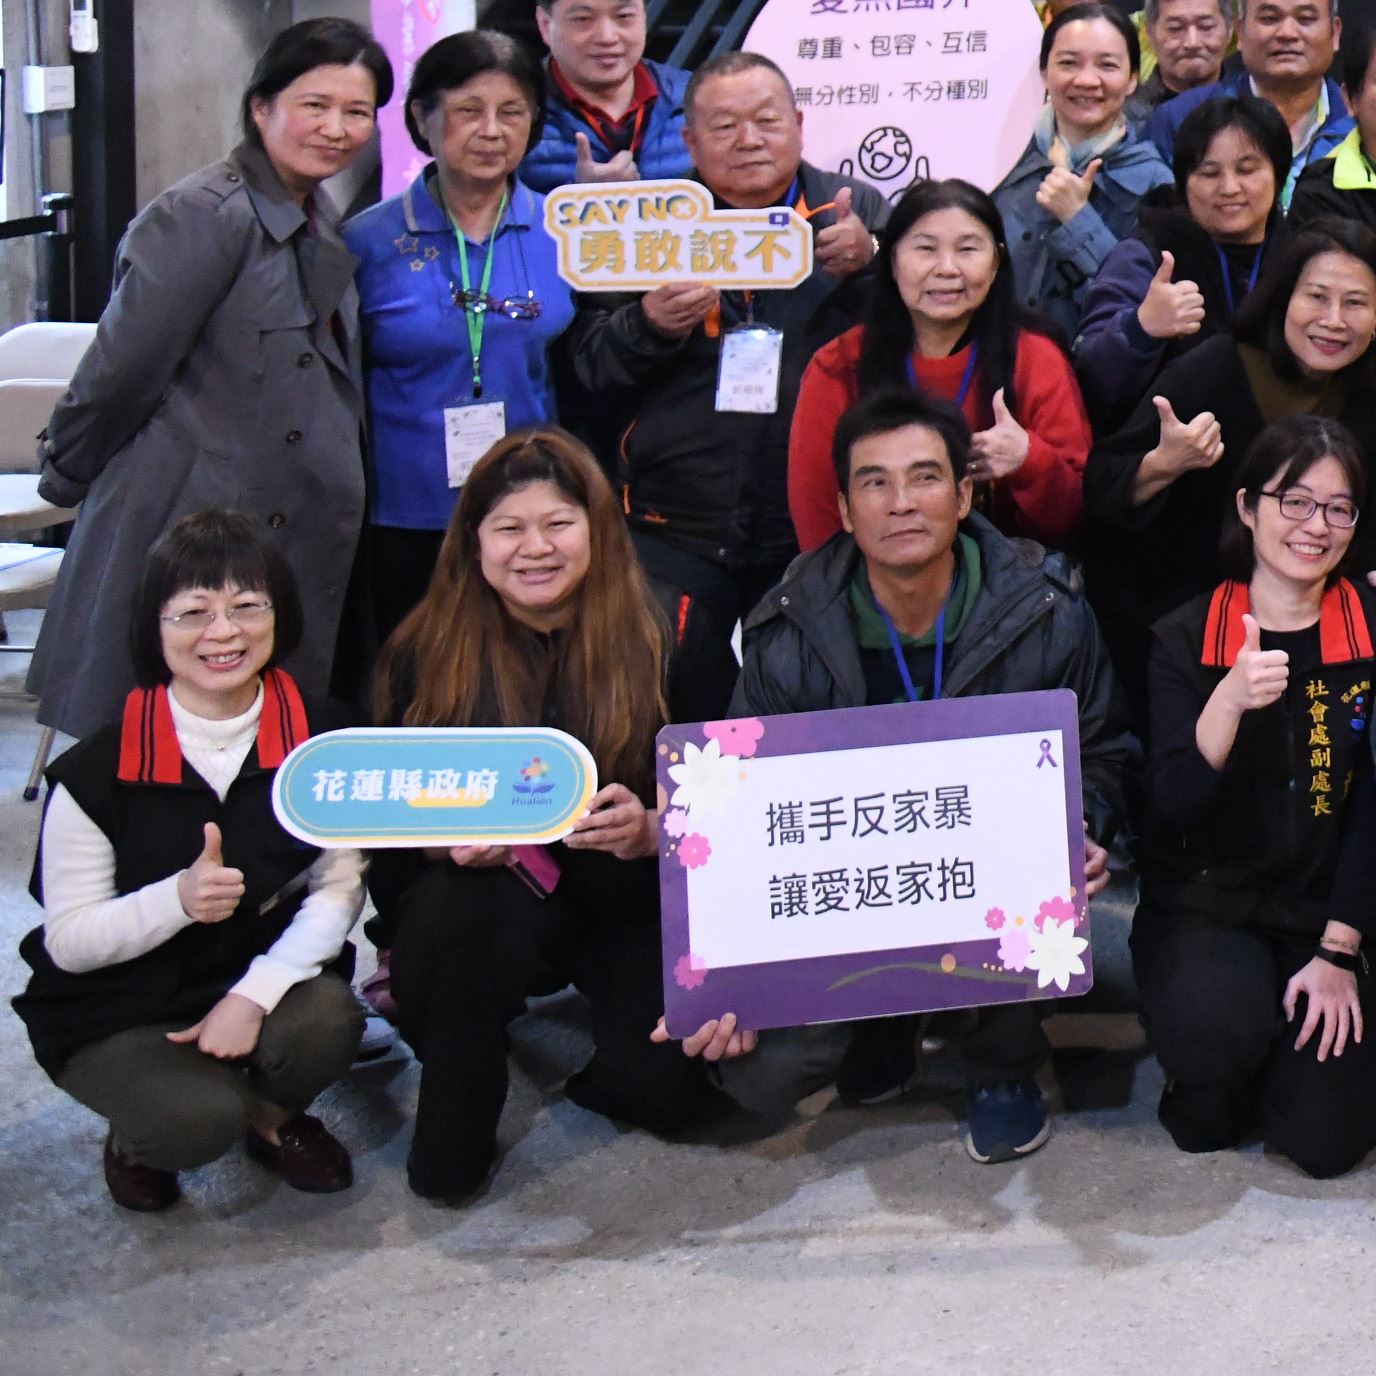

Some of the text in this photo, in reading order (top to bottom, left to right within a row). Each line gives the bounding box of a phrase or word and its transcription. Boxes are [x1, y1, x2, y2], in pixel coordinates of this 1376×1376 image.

[797, 30, 988, 60] 尊重、包容、互信
[794, 79, 988, 106] 無分性別，不分種別
[559, 195, 697, 228] SAY NO
[579, 229, 791, 274] 勇敢說不
[1305, 680, 1333, 816] 社會處副處長
[312, 768, 498, 802] 花蓮縣政府
[511, 796, 553, 807] Hualien
[766, 784, 972, 847] 攜手反家暴
[769, 857, 976, 919] 讓愛返家抱
